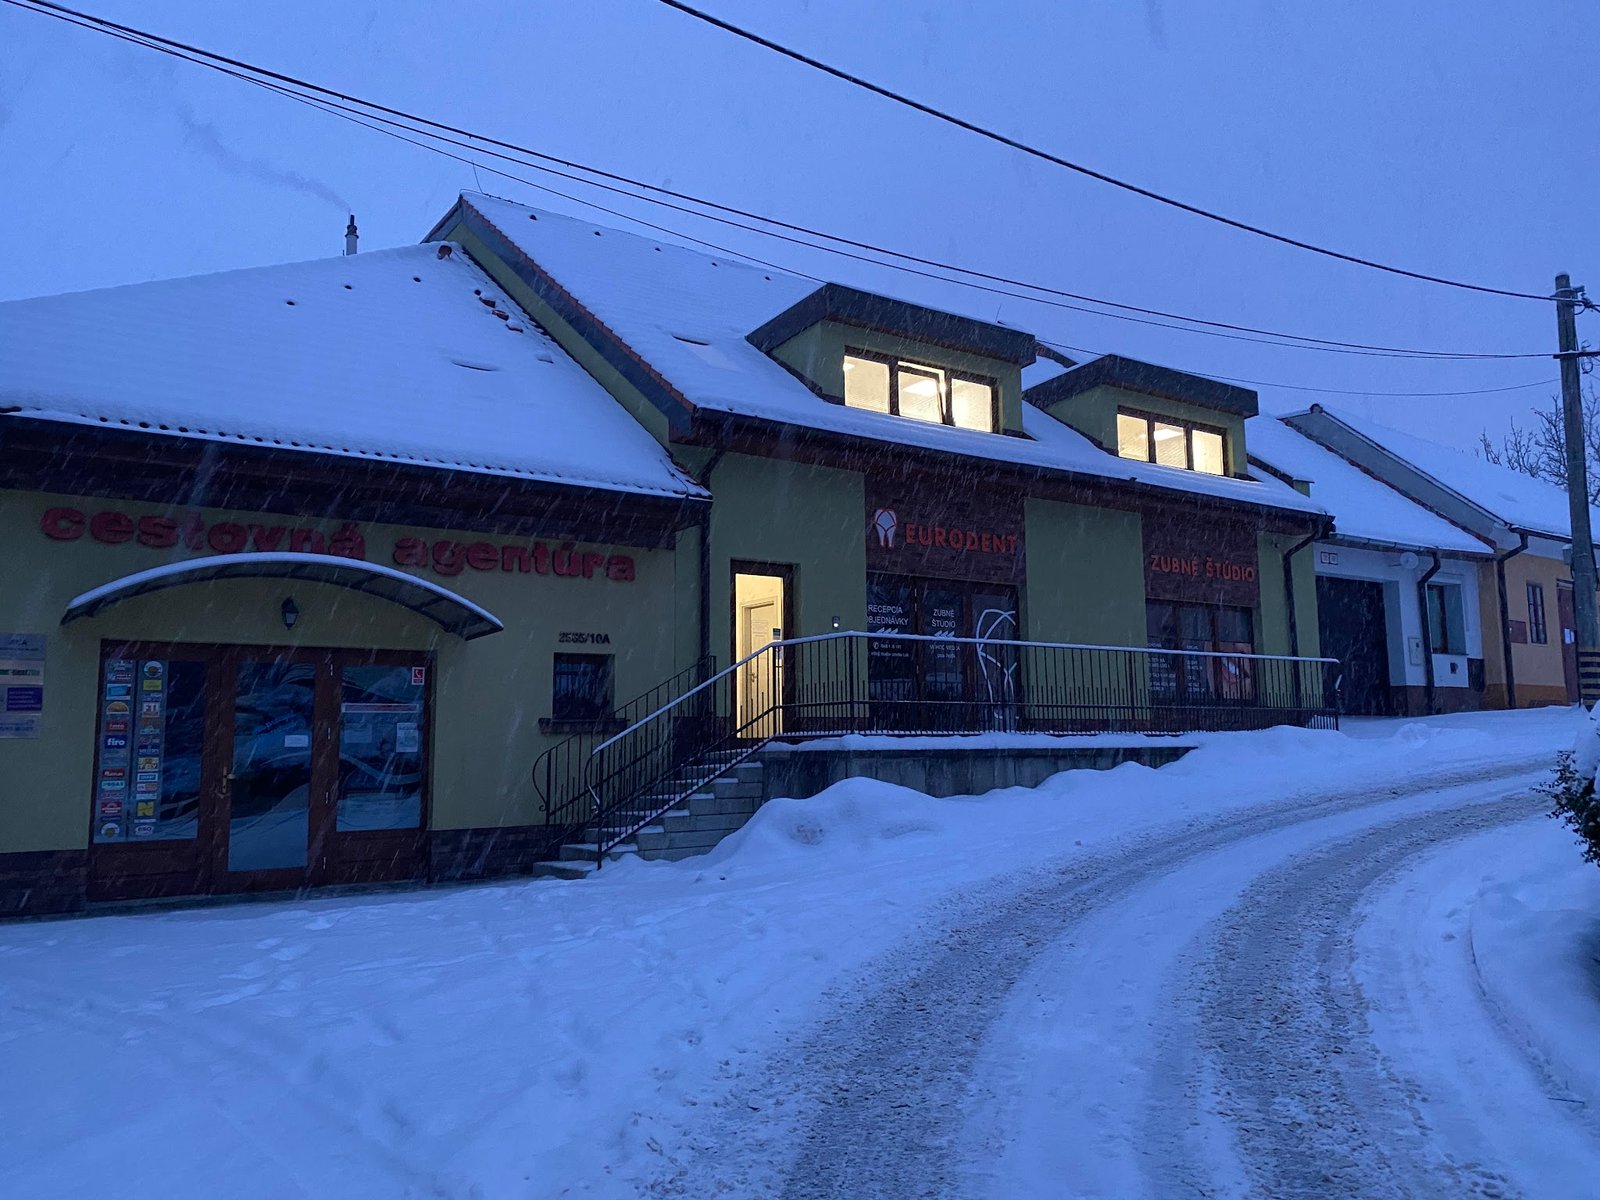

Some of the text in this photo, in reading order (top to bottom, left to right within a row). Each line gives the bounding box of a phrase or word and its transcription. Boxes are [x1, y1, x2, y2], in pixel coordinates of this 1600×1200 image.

[42, 506, 637, 582] cestovná agentúra
[905, 523, 1017, 553] EURODENT
[1151, 555, 1255, 583] ZUBNÉ ŠTÚDIO
[867, 615, 909, 626] BJEDNÁVKY
[106, 737, 126, 746] firo
